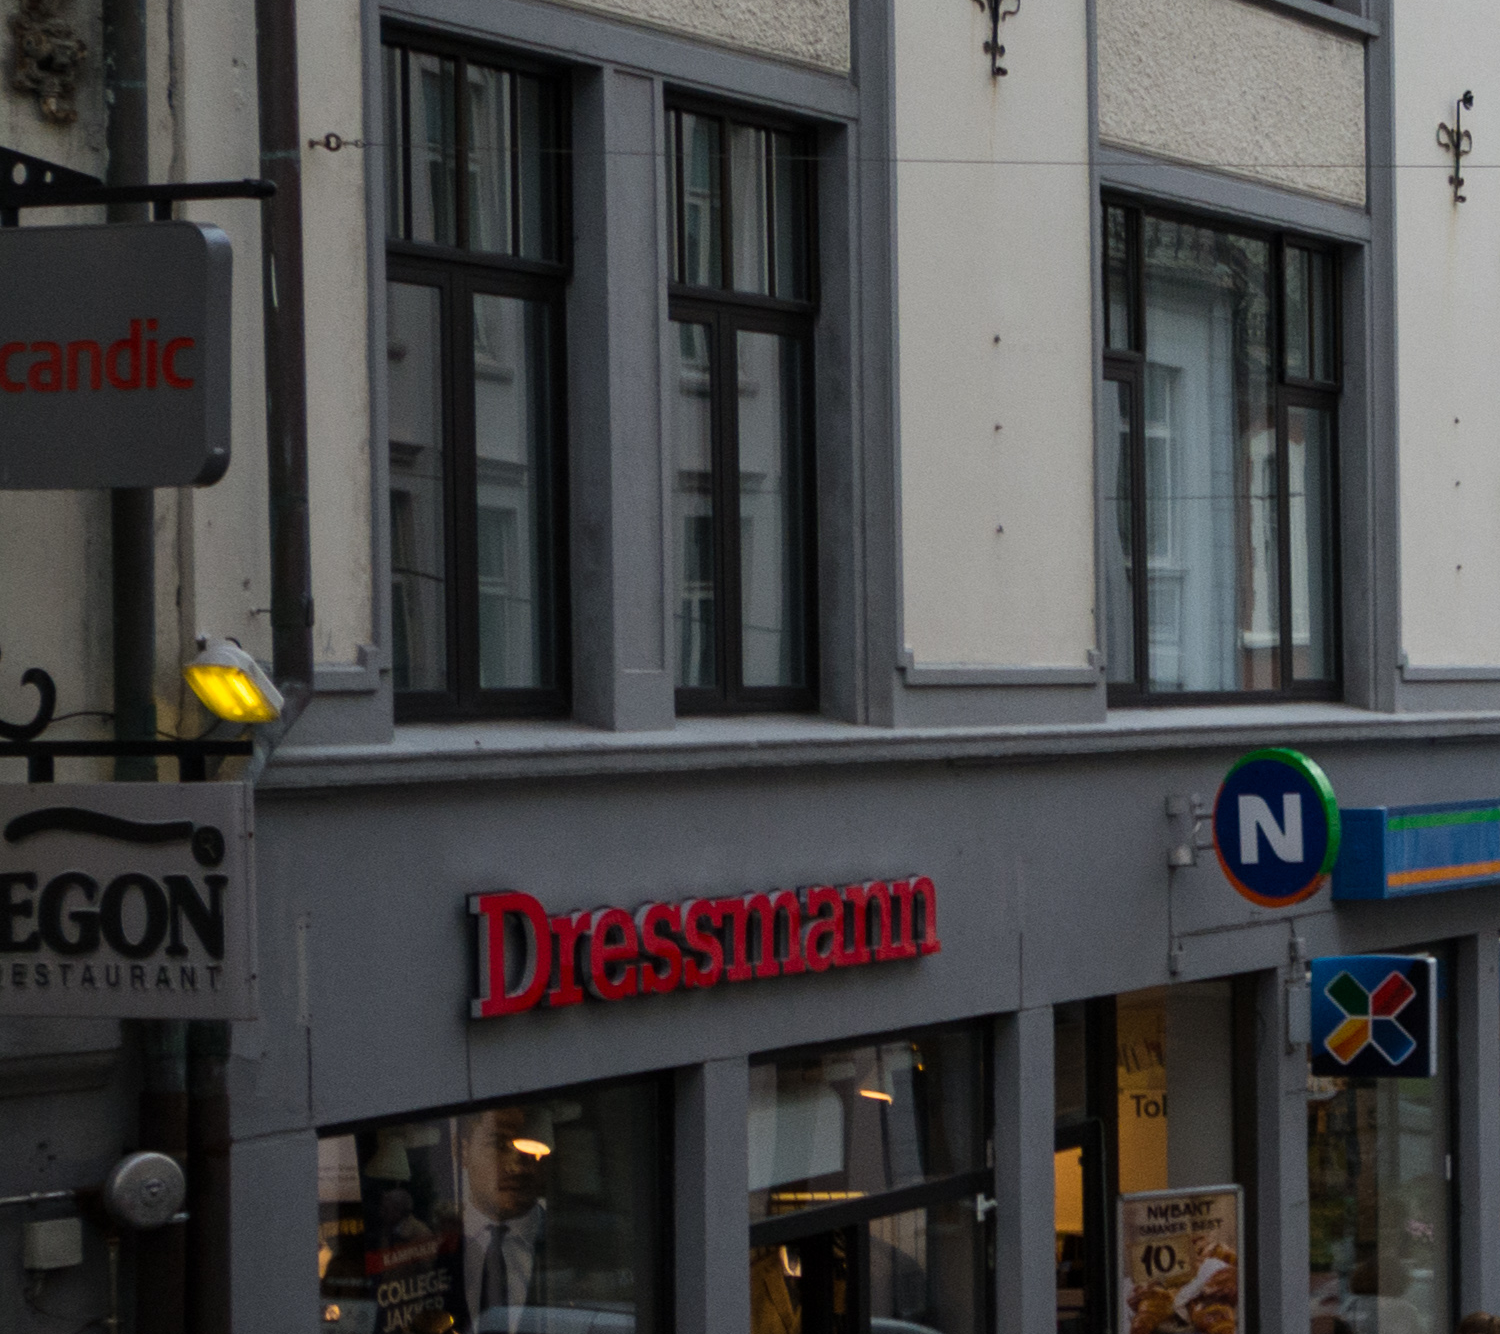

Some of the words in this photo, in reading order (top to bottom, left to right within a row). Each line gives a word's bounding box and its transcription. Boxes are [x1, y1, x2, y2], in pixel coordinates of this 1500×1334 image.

[1237, 793, 1304, 864] N
[0, 870, 229, 961] EGON
[468, 873, 941, 1019] Dressmann
